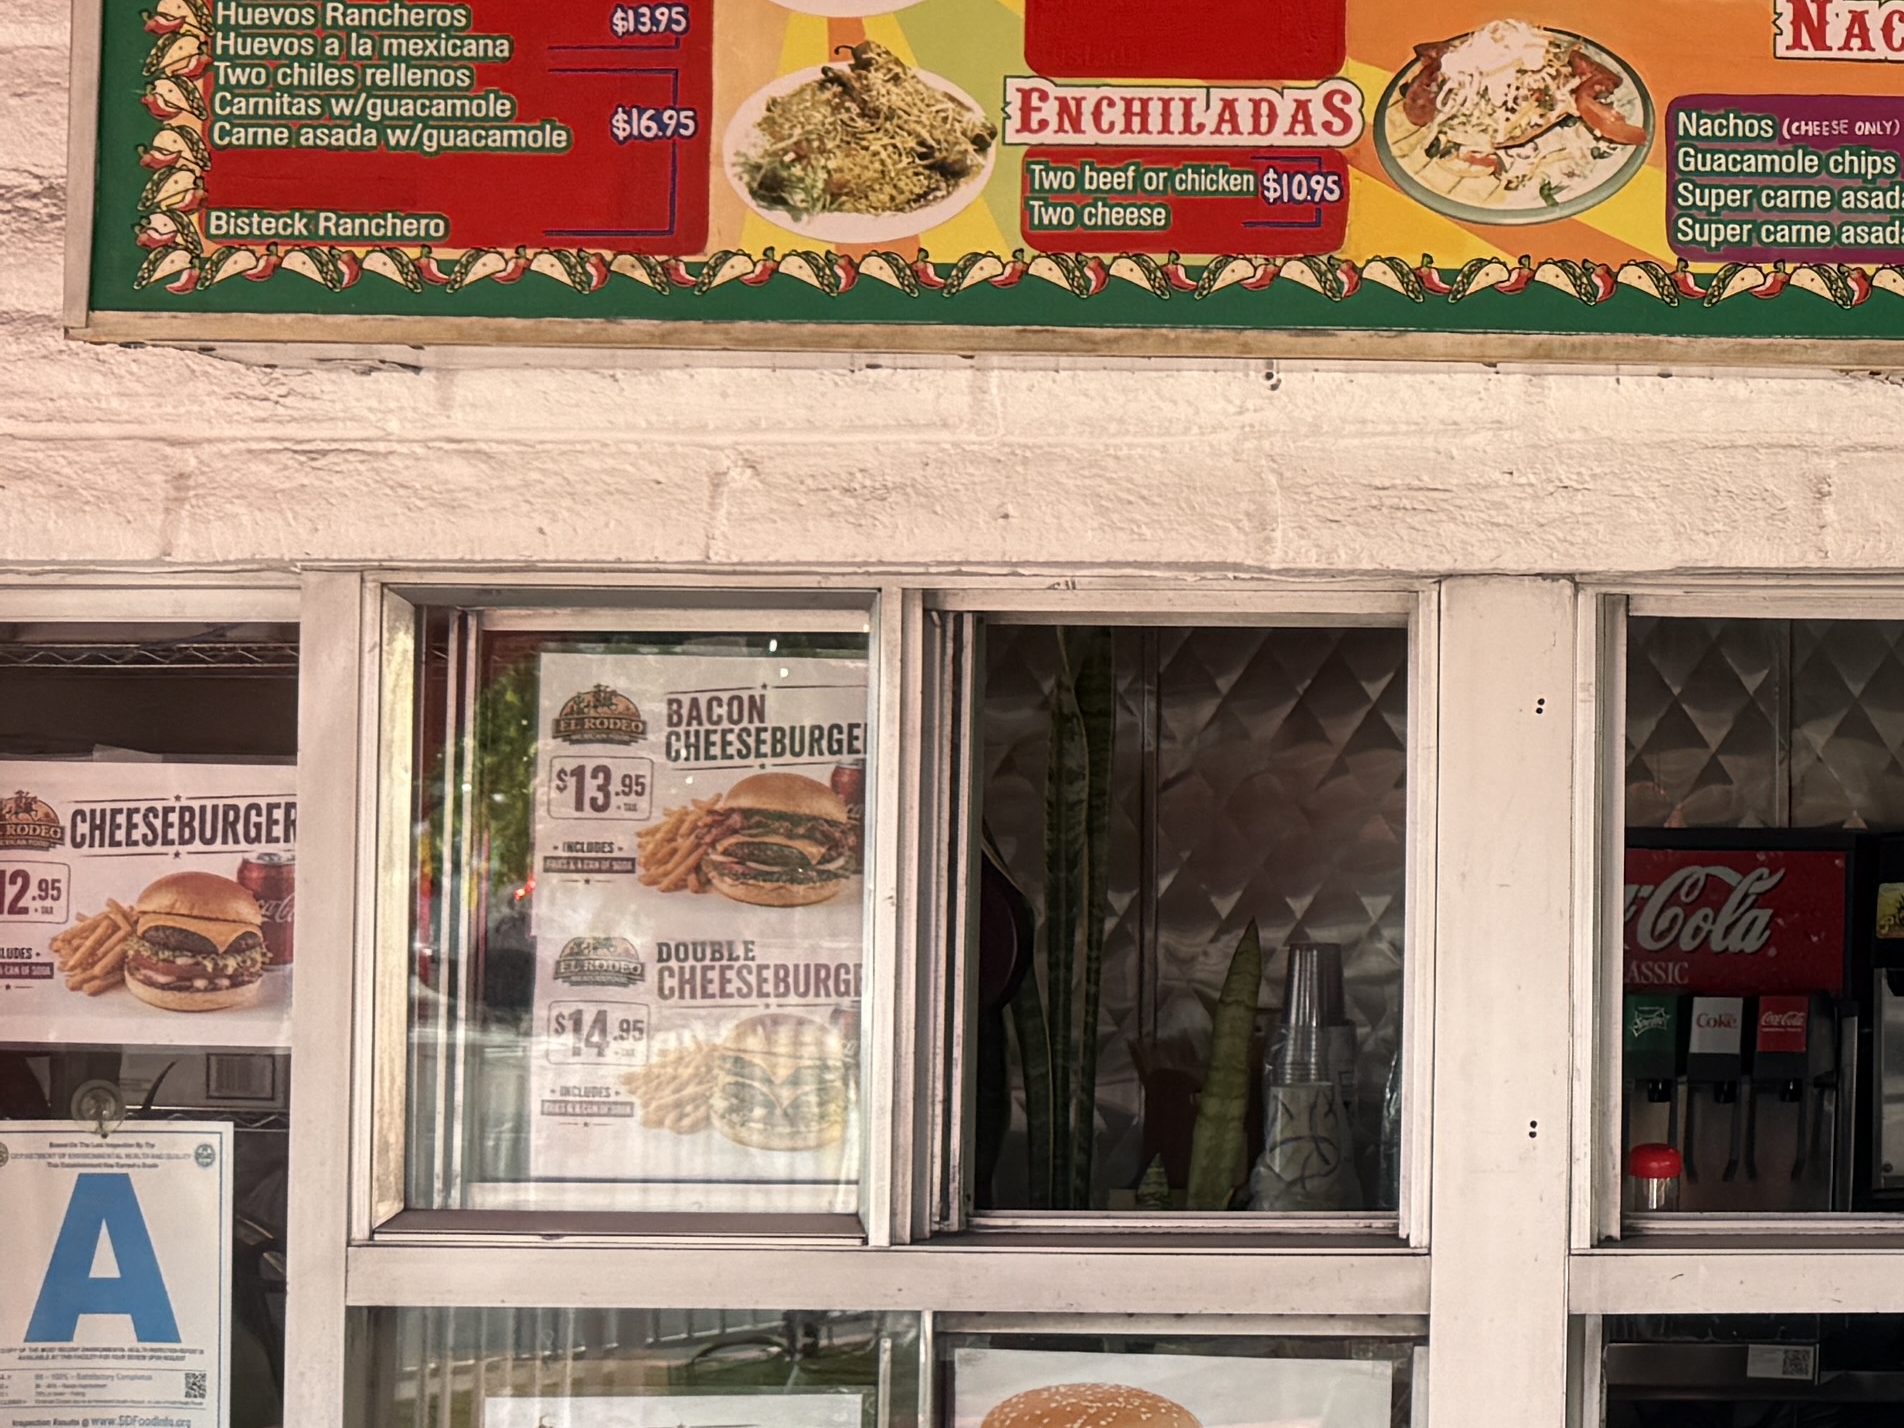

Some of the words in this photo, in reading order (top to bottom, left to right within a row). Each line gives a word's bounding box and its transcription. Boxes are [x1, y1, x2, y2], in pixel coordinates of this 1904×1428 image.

[218, 4, 314, 26] Huevos
[326, 4, 466, 26] Rancheros
[612, 7, 686, 34] $13.95
[1017, 88, 1354, 136] ENCHILADAS
[1678, 150, 1818, 174] Guacamole
[1829, 150, 1896, 181] chips
[1264, 172, 1340, 205] $10.95
[210, 213, 306, 236] Bisteck
[319, 213, 444, 238] Ranchero
[667, 694, 766, 727] BACON
[657, 941, 755, 962] DOUBLE
[23, 1173, 181, 1342] A
